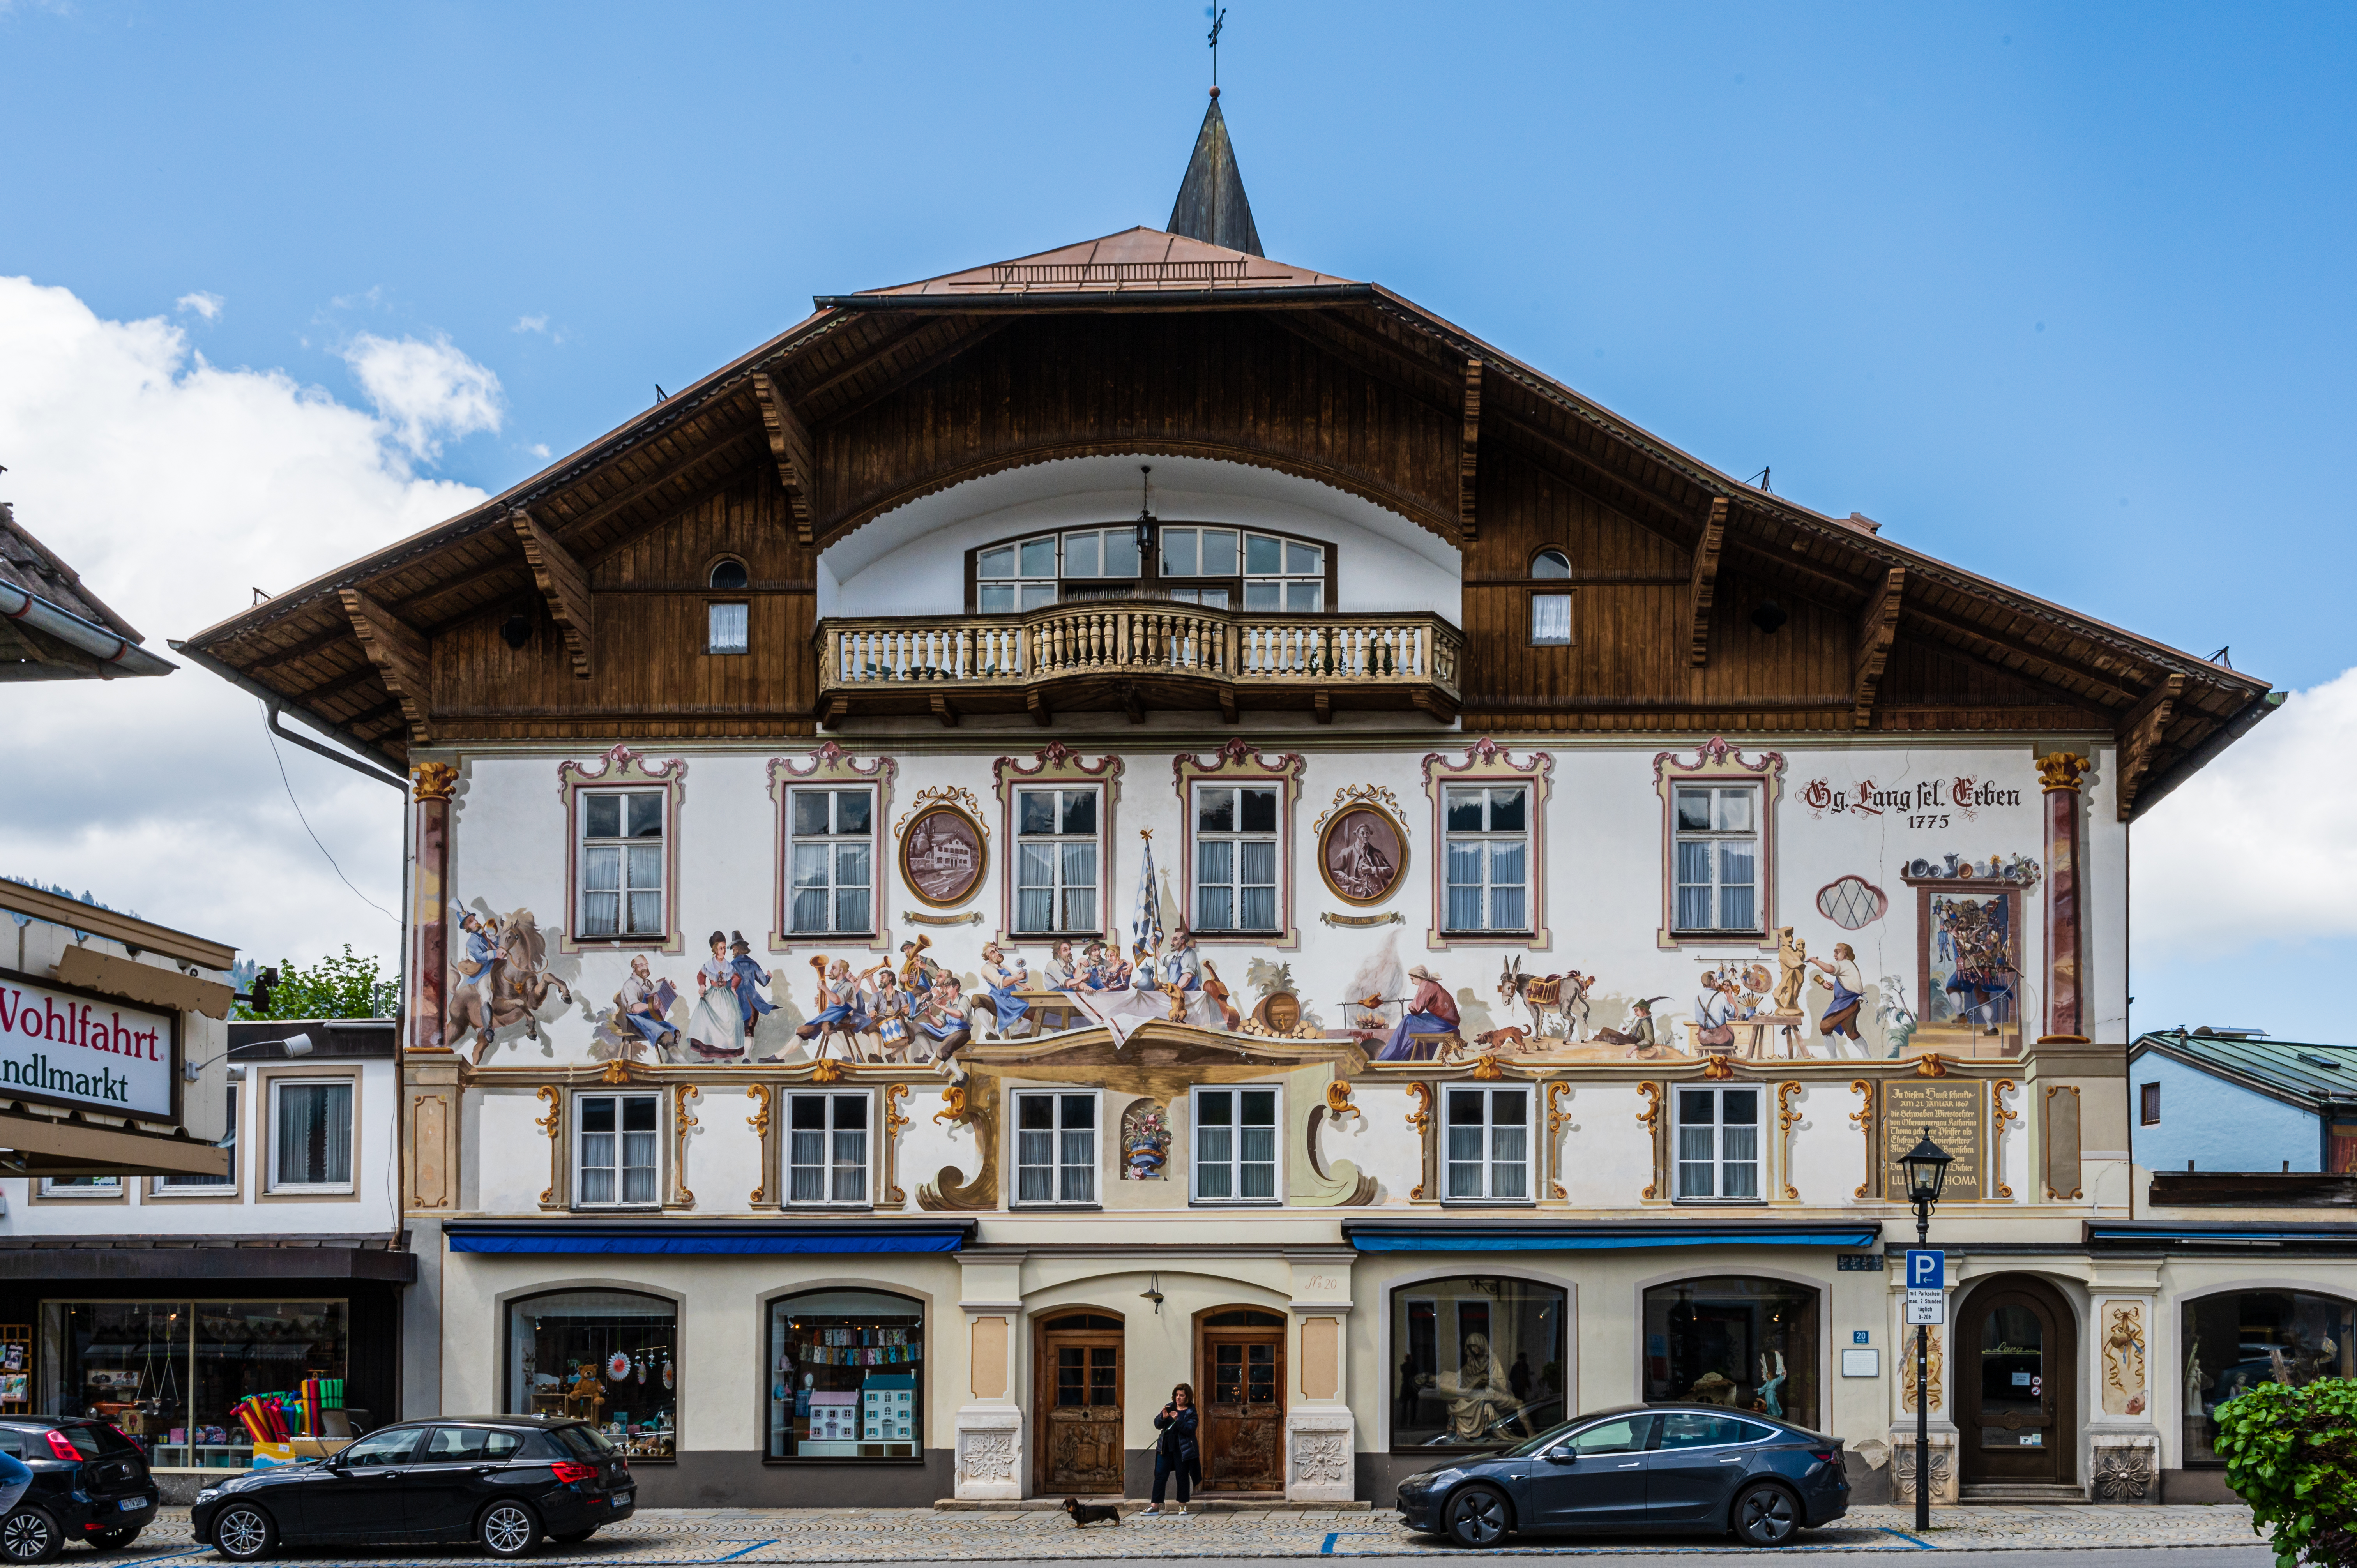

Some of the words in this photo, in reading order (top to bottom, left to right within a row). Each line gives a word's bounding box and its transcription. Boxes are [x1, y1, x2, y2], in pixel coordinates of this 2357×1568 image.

[1848, 775, 1912, 820] Lang
[1946, 774, 2021, 822] Erben
[1907, 814, 1950, 828] 1775
[912, 913, 942, 923] VERLEGEREI
[959, 913, 972, 922] 1875
[1330, 915, 1352, 924] GEORG
[1374, 914, 1389, 922] 1770
[0, 1053, 128, 1102] ndlmarkt
[1891, 1089, 1903, 1098] In
[1900, 1109, 1933, 1118] Schwaben
[1935, 1109, 1974, 1118] Wirtstochter
[1902, 1119, 1947, 1127] Oberammergau
[1948, 1118, 1977, 1127] Katharina
[1890, 1127, 1912, 1135] Thoma
[1913, 1127, 1937, 1135] geboene
[1938, 1127, 1961, 1137] Pfeiffer
[1891, 1135, 1914, 1144] Ehefrau
[1890, 1144, 1906, 1153] Max
[1950, 1163, 1973, 1172] Dichter
[1944, 1176, 1977, 1185] HOMA
[1916, 1255, 1935, 1284] P
[1324, 1279, 1337, 1289] 20
